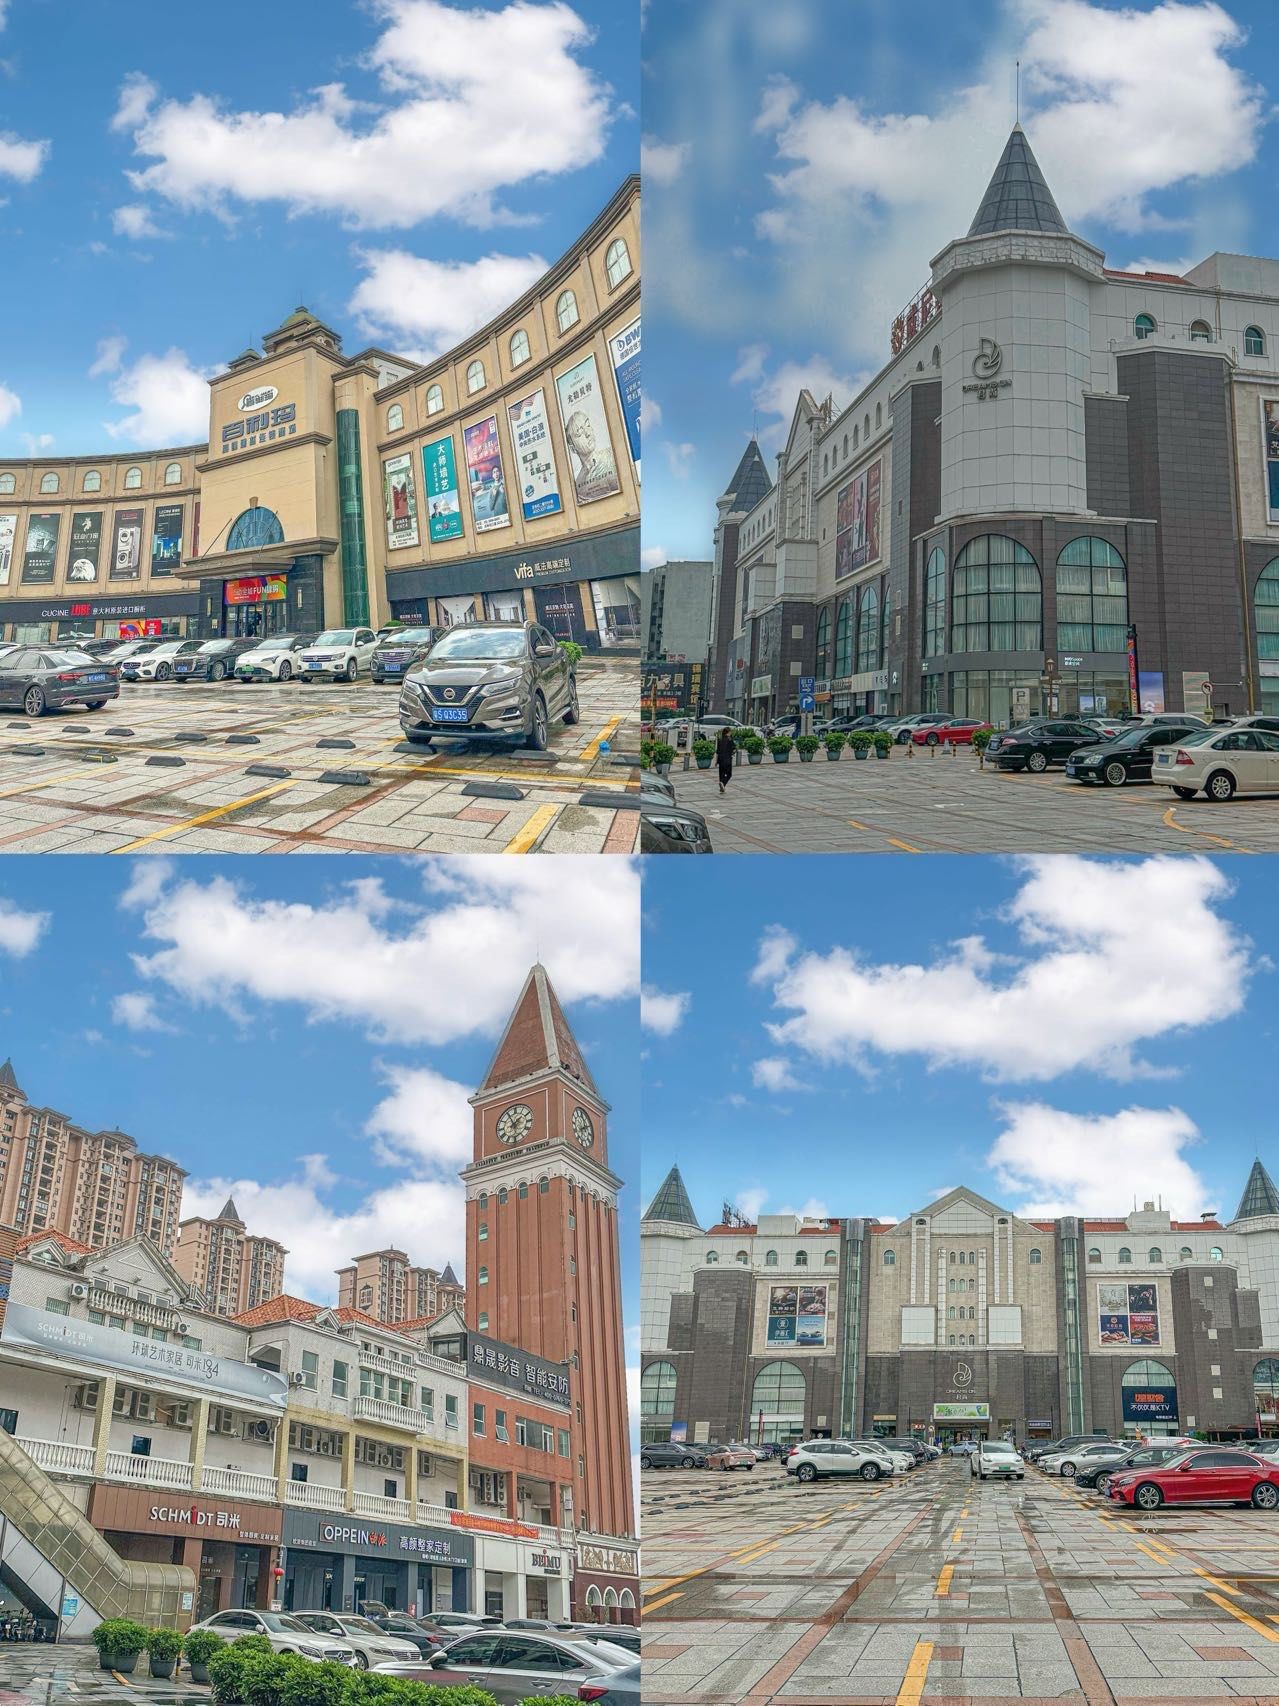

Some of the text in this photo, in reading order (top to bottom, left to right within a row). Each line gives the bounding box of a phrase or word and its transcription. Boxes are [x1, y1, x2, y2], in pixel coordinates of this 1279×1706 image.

[222, 403, 296, 442] 百利玛
[514, 562, 534, 579] vifa
[41, 609, 69, 617] CUCINE
[132, 1341, 183, 1366] 环球艺术家居
[525, 1363, 568, 1395] 智能安防
[216, 1511, 241, 1529] 司米
[324, 1525, 369, 1545] OPPEIN
[400, 1536, 450, 1555] 高颜整家定制
